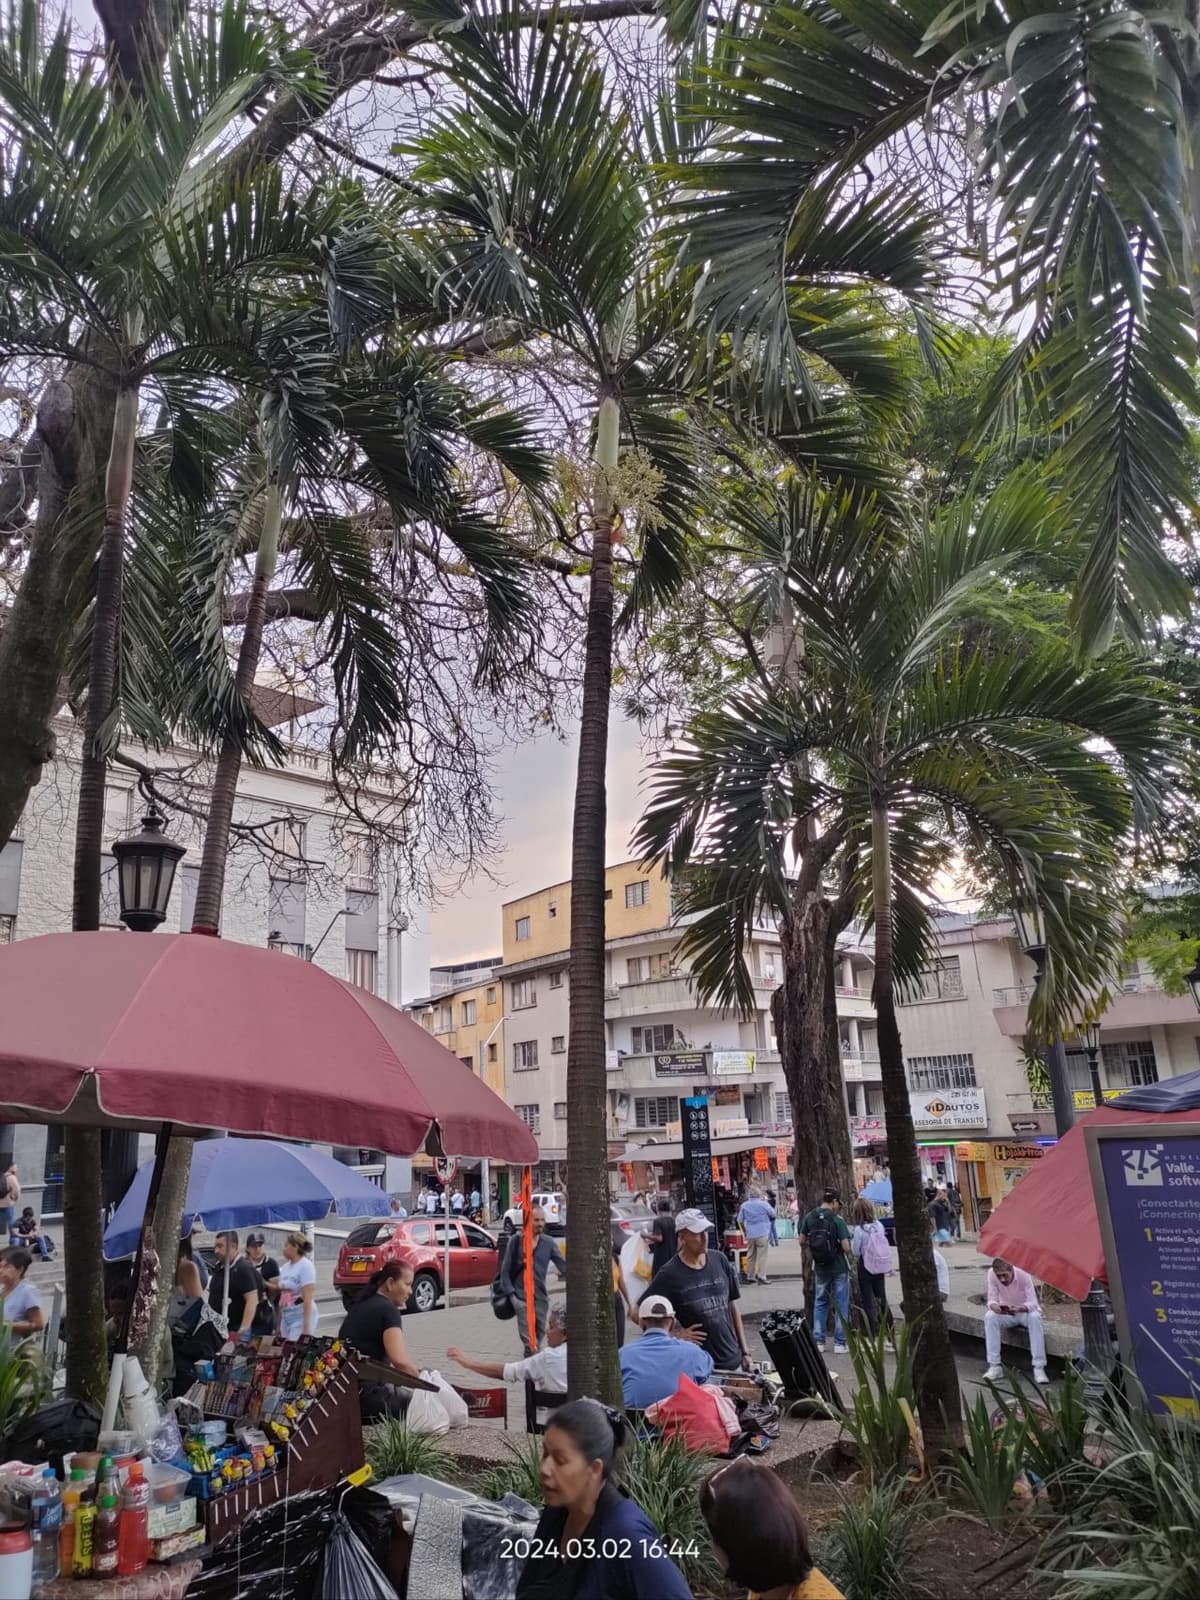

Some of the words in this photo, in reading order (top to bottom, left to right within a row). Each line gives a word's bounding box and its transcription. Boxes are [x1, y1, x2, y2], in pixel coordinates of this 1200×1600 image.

[1143, 1227, 1152, 1242] 1
[1151, 1280, 1163, 1296] 2
[1155, 1307, 1167, 1323] 3
